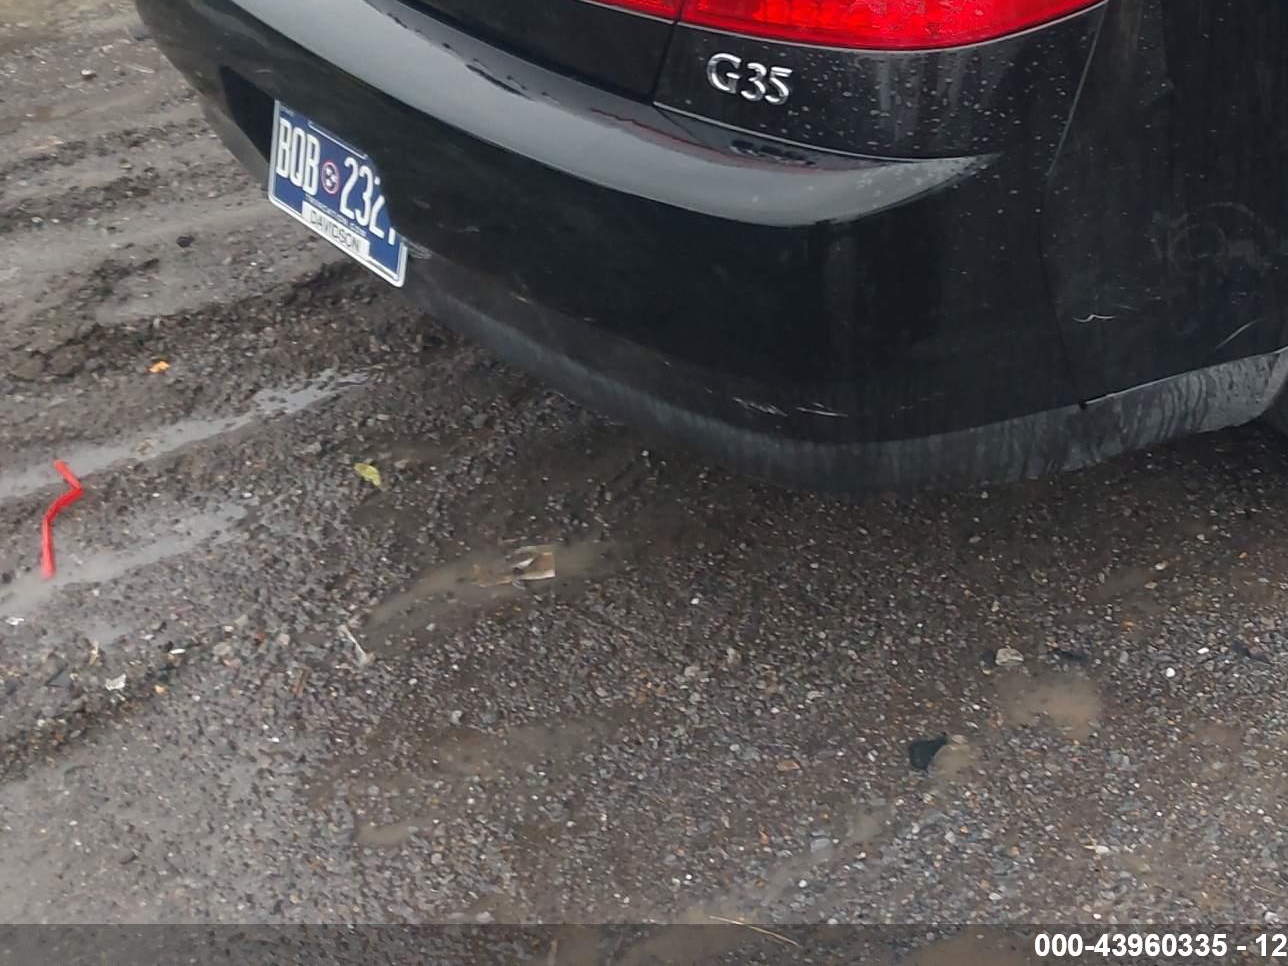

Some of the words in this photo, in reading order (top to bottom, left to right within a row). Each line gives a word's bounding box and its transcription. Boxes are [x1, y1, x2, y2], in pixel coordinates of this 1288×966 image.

[706, 52, 793, 105] G35
[339, 156, 397, 246] 232
[310, 209, 361, 255] DAVIDSON
